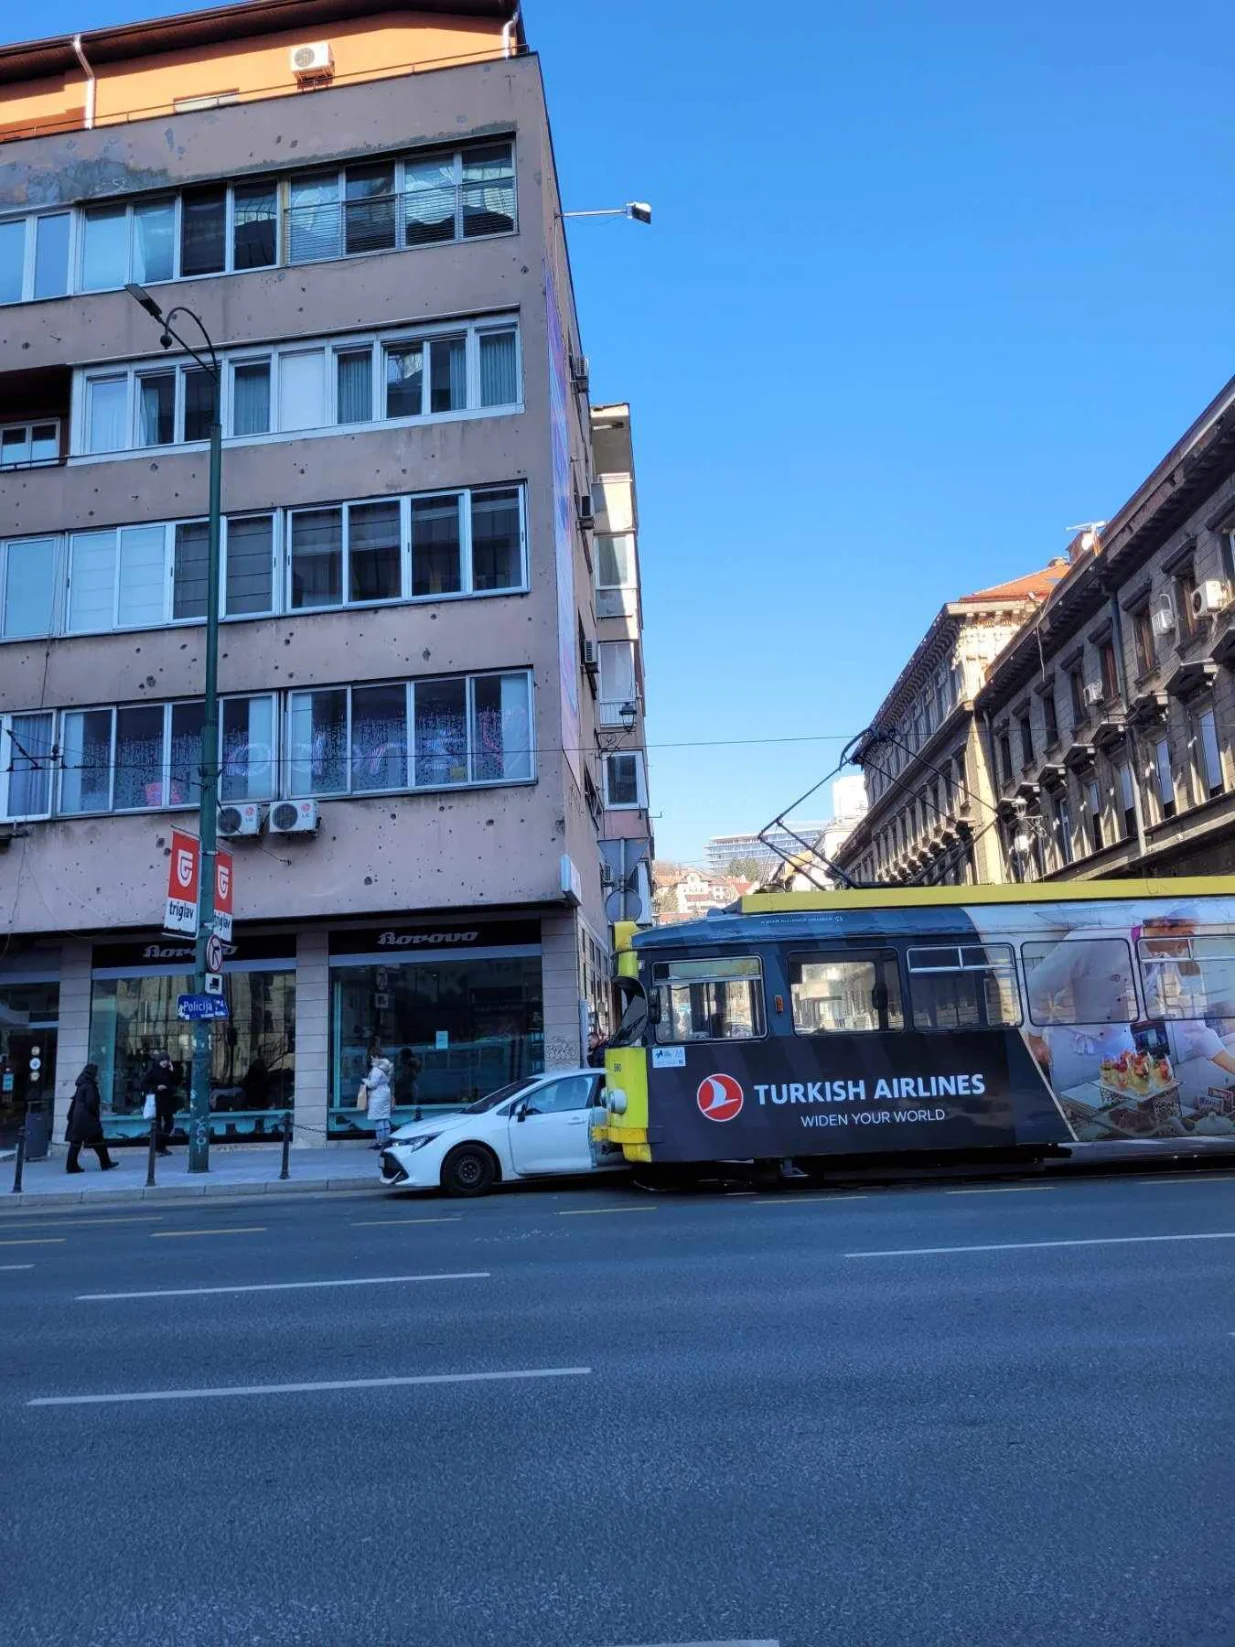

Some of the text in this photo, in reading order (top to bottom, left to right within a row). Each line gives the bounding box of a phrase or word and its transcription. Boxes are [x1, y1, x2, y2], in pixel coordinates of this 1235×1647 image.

[169, 901, 196, 921] triglav
[377, 931, 479, 945] Borovo
[183, 1001, 213, 1013] Policija
[754, 1074, 986, 1105] TURKISH AIRLINES
[801, 1108, 945, 1128] WIDEN YOUR WORLD
